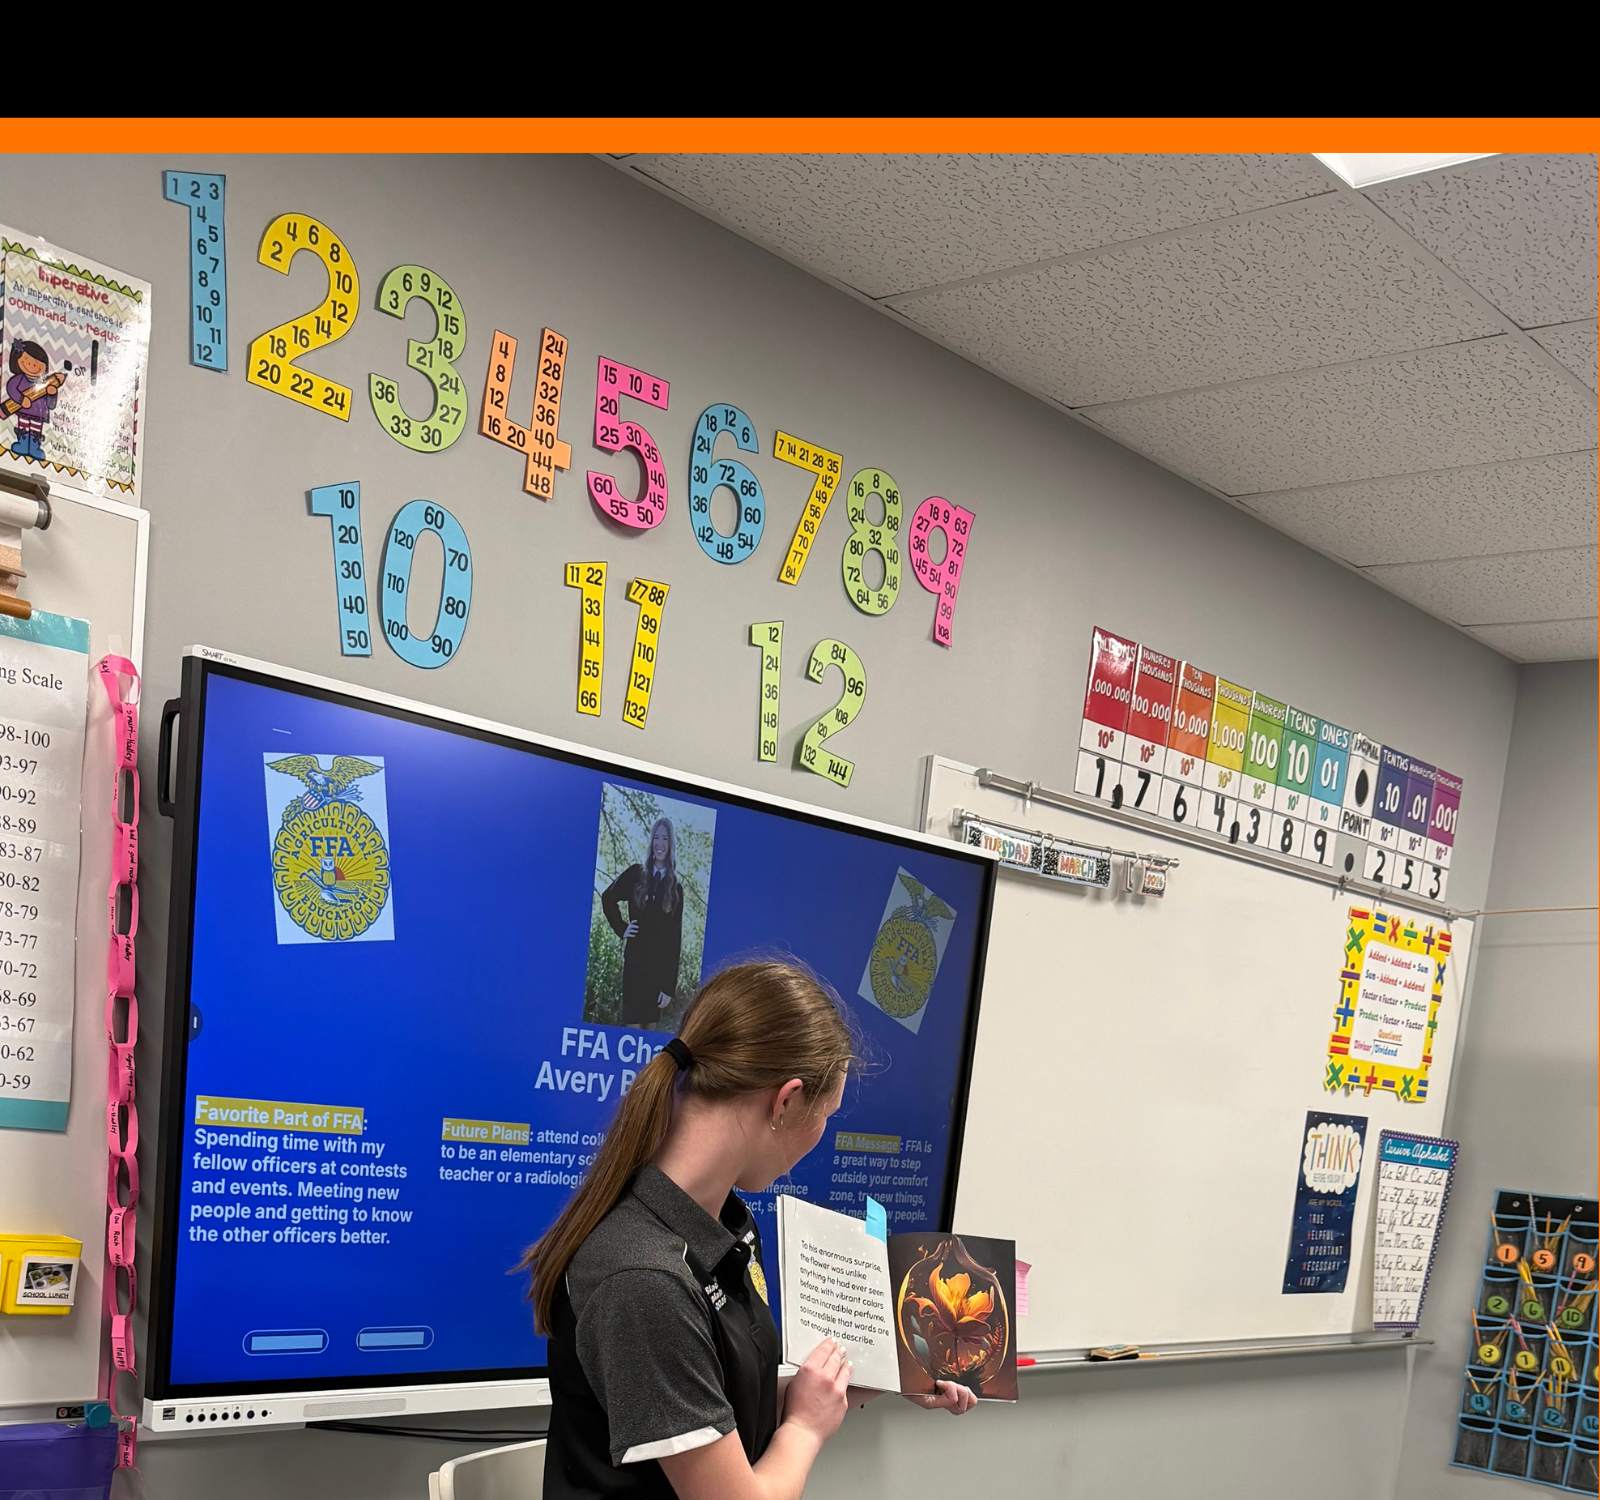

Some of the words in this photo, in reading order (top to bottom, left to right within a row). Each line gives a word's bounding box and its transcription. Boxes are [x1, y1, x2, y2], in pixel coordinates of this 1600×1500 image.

[375, 379, 396, 403] 36
[531, 474, 550, 494] 48
[594, 477, 612, 495] 60
[202, 648, 225, 662] SMART
[23, 668, 62, 690] Scale
[1249, 732, 1278, 770] 100
[1288, 740, 1309, 784] 10
[1321, 758, 1339, 790] 01
[0, 843, 42, 863] 83-87
[310, 836, 354, 858] FFA
[562, 1028, 609, 1060] FFA
[535, 1061, 614, 1101] Avery
[195, 1128, 278, 1152] Spending
[283, 1133, 319, 1151] time
[324, 1137, 357, 1153] with
[362, 1142, 385, 1158] my
[1310, 1133, 1357, 1173] THINK
[193, 1152, 247, 1170] fellow
[252, 1156, 316, 1174] officers
[321, 1161, 336, 1175] at
[341, 1163, 407, 1178] contests
[842, 1156, 866, 1168] great
[869, 1158, 888, 1172] way
[890, 1158, 899, 1169] to
[902, 1159, 921, 1172] step
[832, 1171, 867, 1184] outside
[869, 1176, 891, 1187] your
[893, 1175, 928, 1187] comfort
[819, 1248, 852, 1264] enormous
[23, 1290, 46, 1299] SCHOOL
[48, 1290, 69, 1300] LUNCH
[842, 1332, 875, 1346] describe.
[855, 1323, 876, 1333] words
